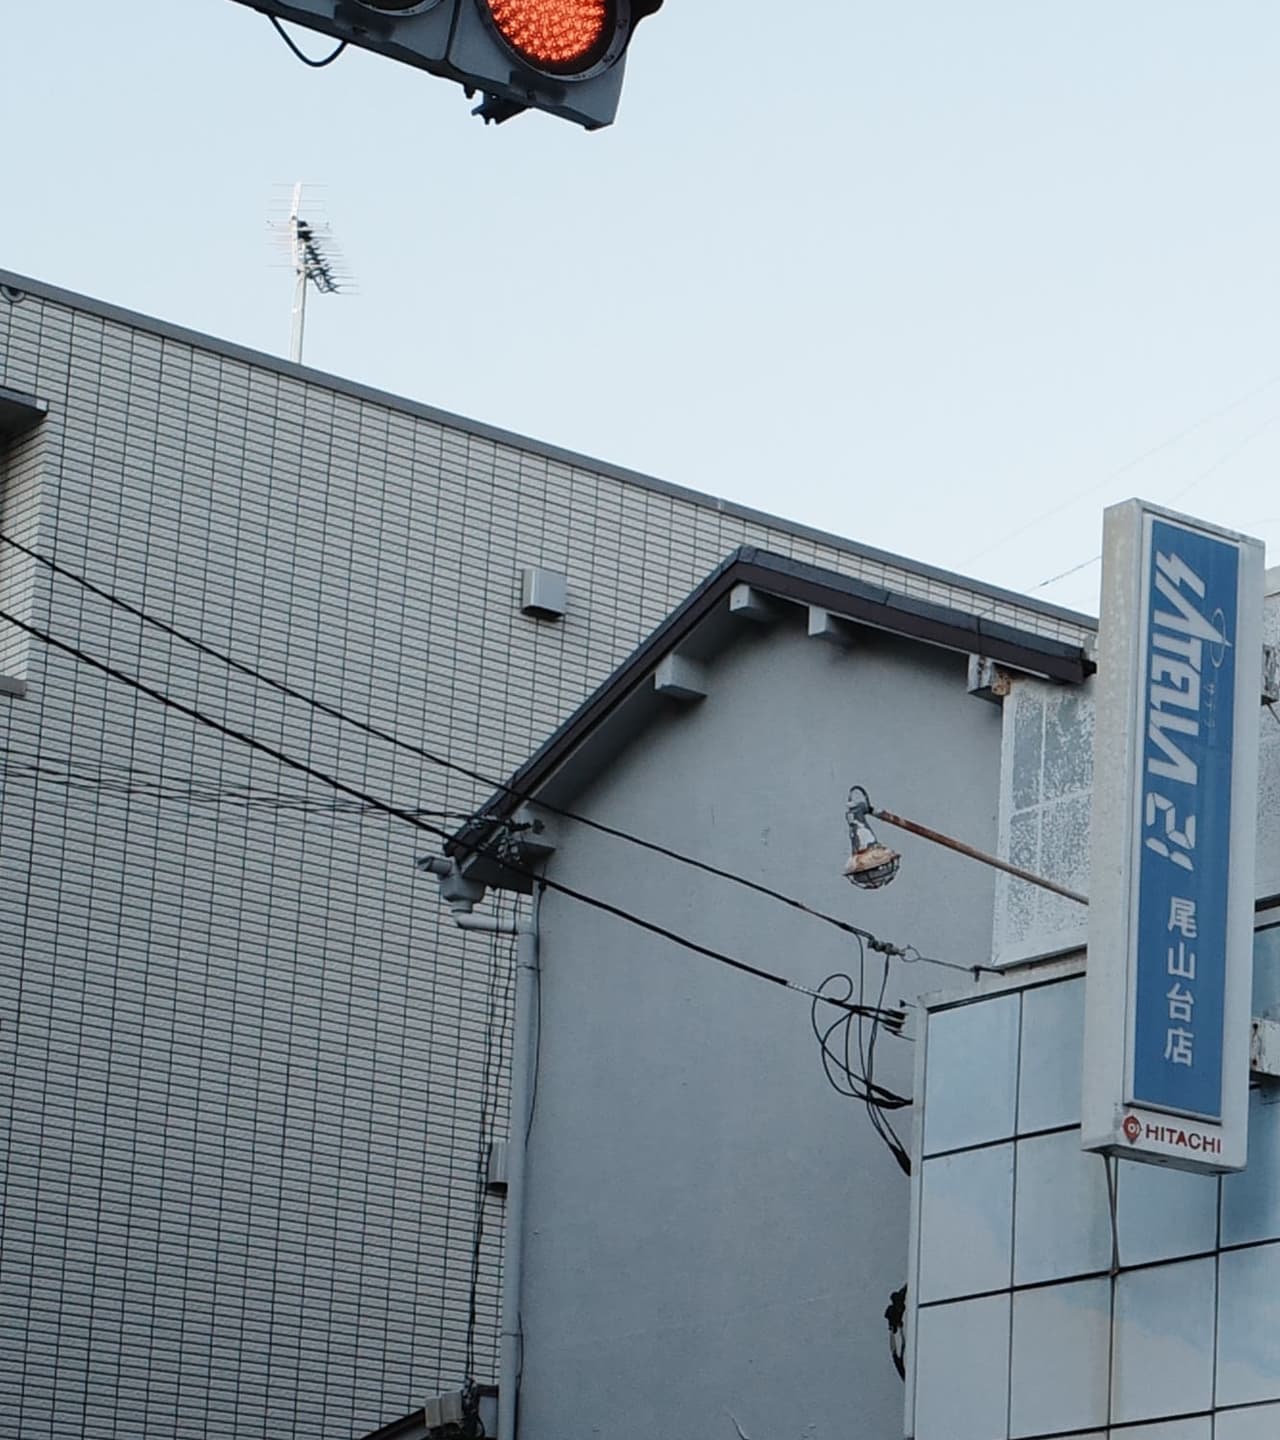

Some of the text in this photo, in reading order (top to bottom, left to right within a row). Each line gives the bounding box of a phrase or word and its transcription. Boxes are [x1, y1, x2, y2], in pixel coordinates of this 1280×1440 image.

[1163, 896, 1199, 1067] 尾山台店
[1145, 1123, 1221, 1154] HITACHI
